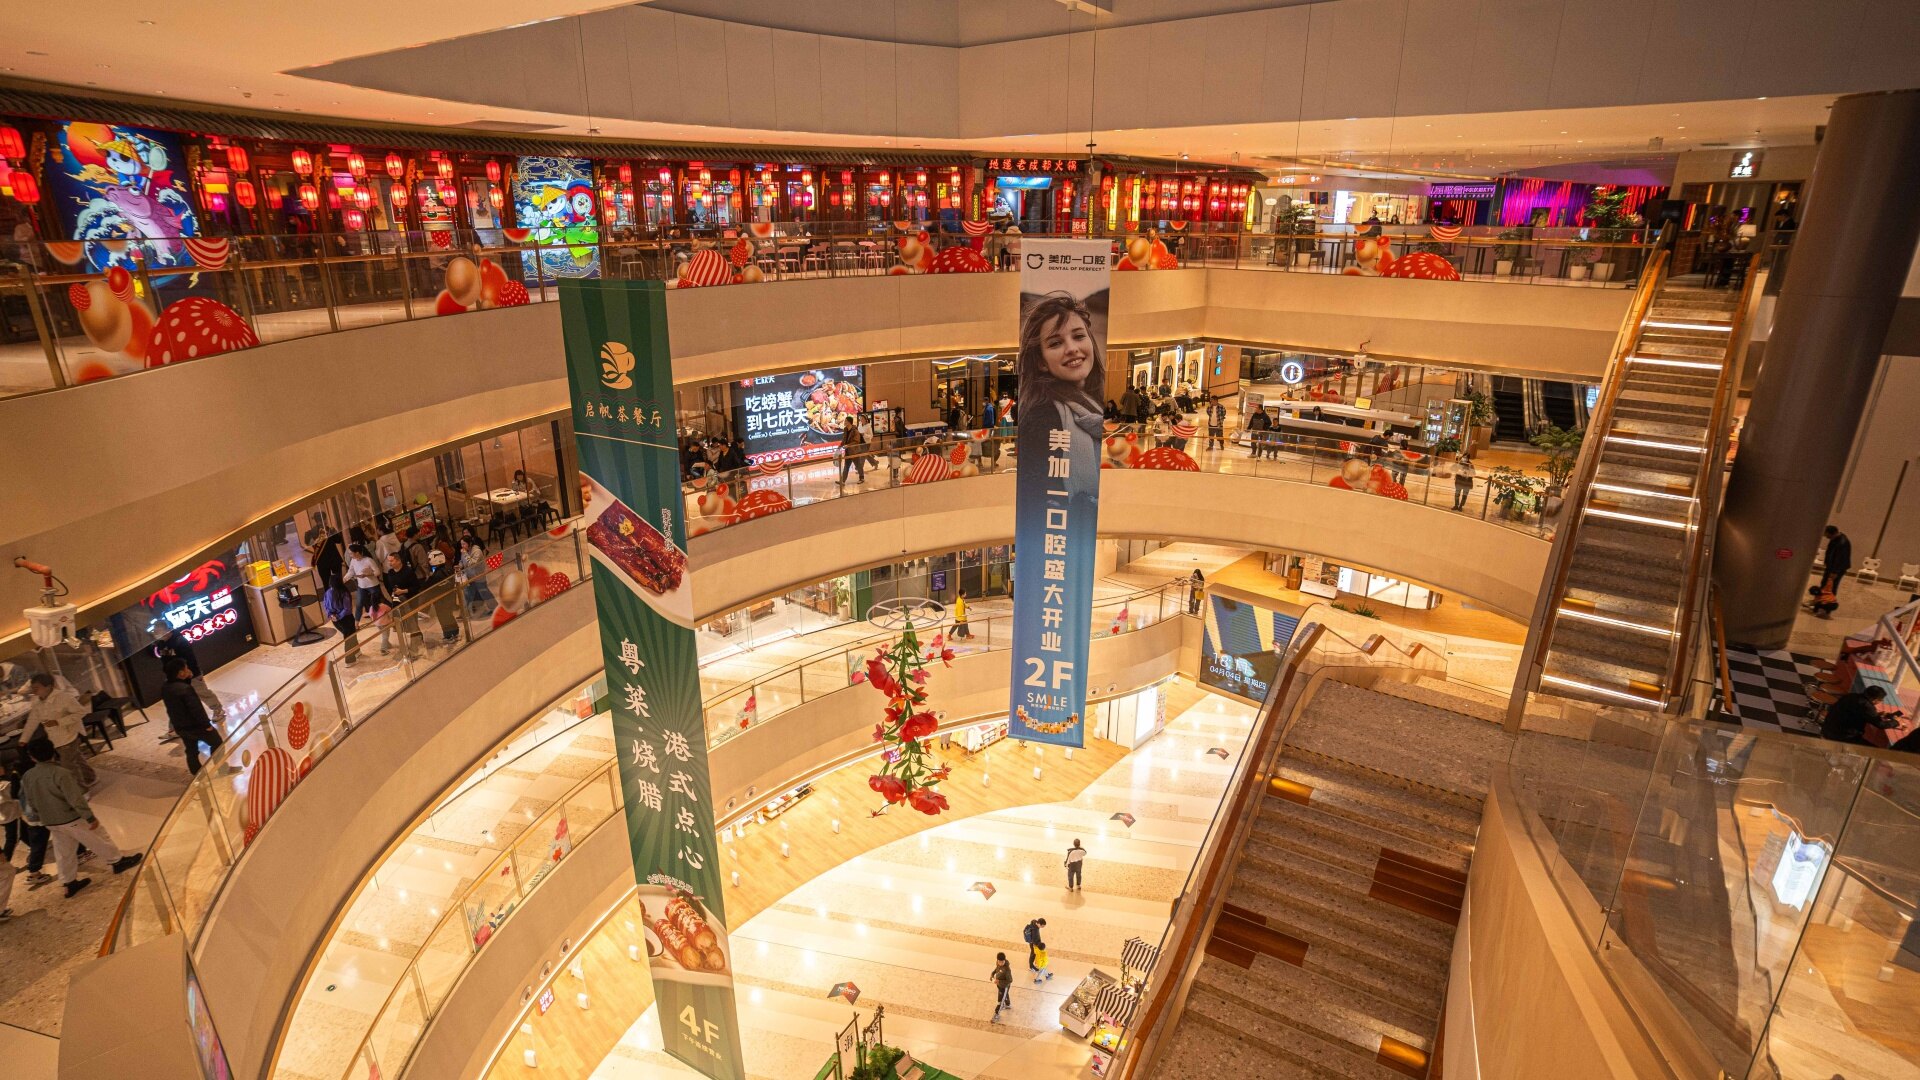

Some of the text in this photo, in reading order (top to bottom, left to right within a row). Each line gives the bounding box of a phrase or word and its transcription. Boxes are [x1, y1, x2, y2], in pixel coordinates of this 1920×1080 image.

[1048, 254, 1106, 265] 美加一口腔
[584, 400, 663, 429] 启帆茶餐厅
[745, 390, 793, 413] 吃螃蟹
[746, 408, 809, 432] 到七欣天
[1040, 429, 1071, 653] 美加一口腔盛大开业
[1023, 656, 1074, 690] 2F
[1209, 665, 1241, 682] 04月04日
[1027, 692, 1068, 708] SMILE
[662, 728, 705, 870] 港式点心
[679, 1004, 720, 1045] 4F
